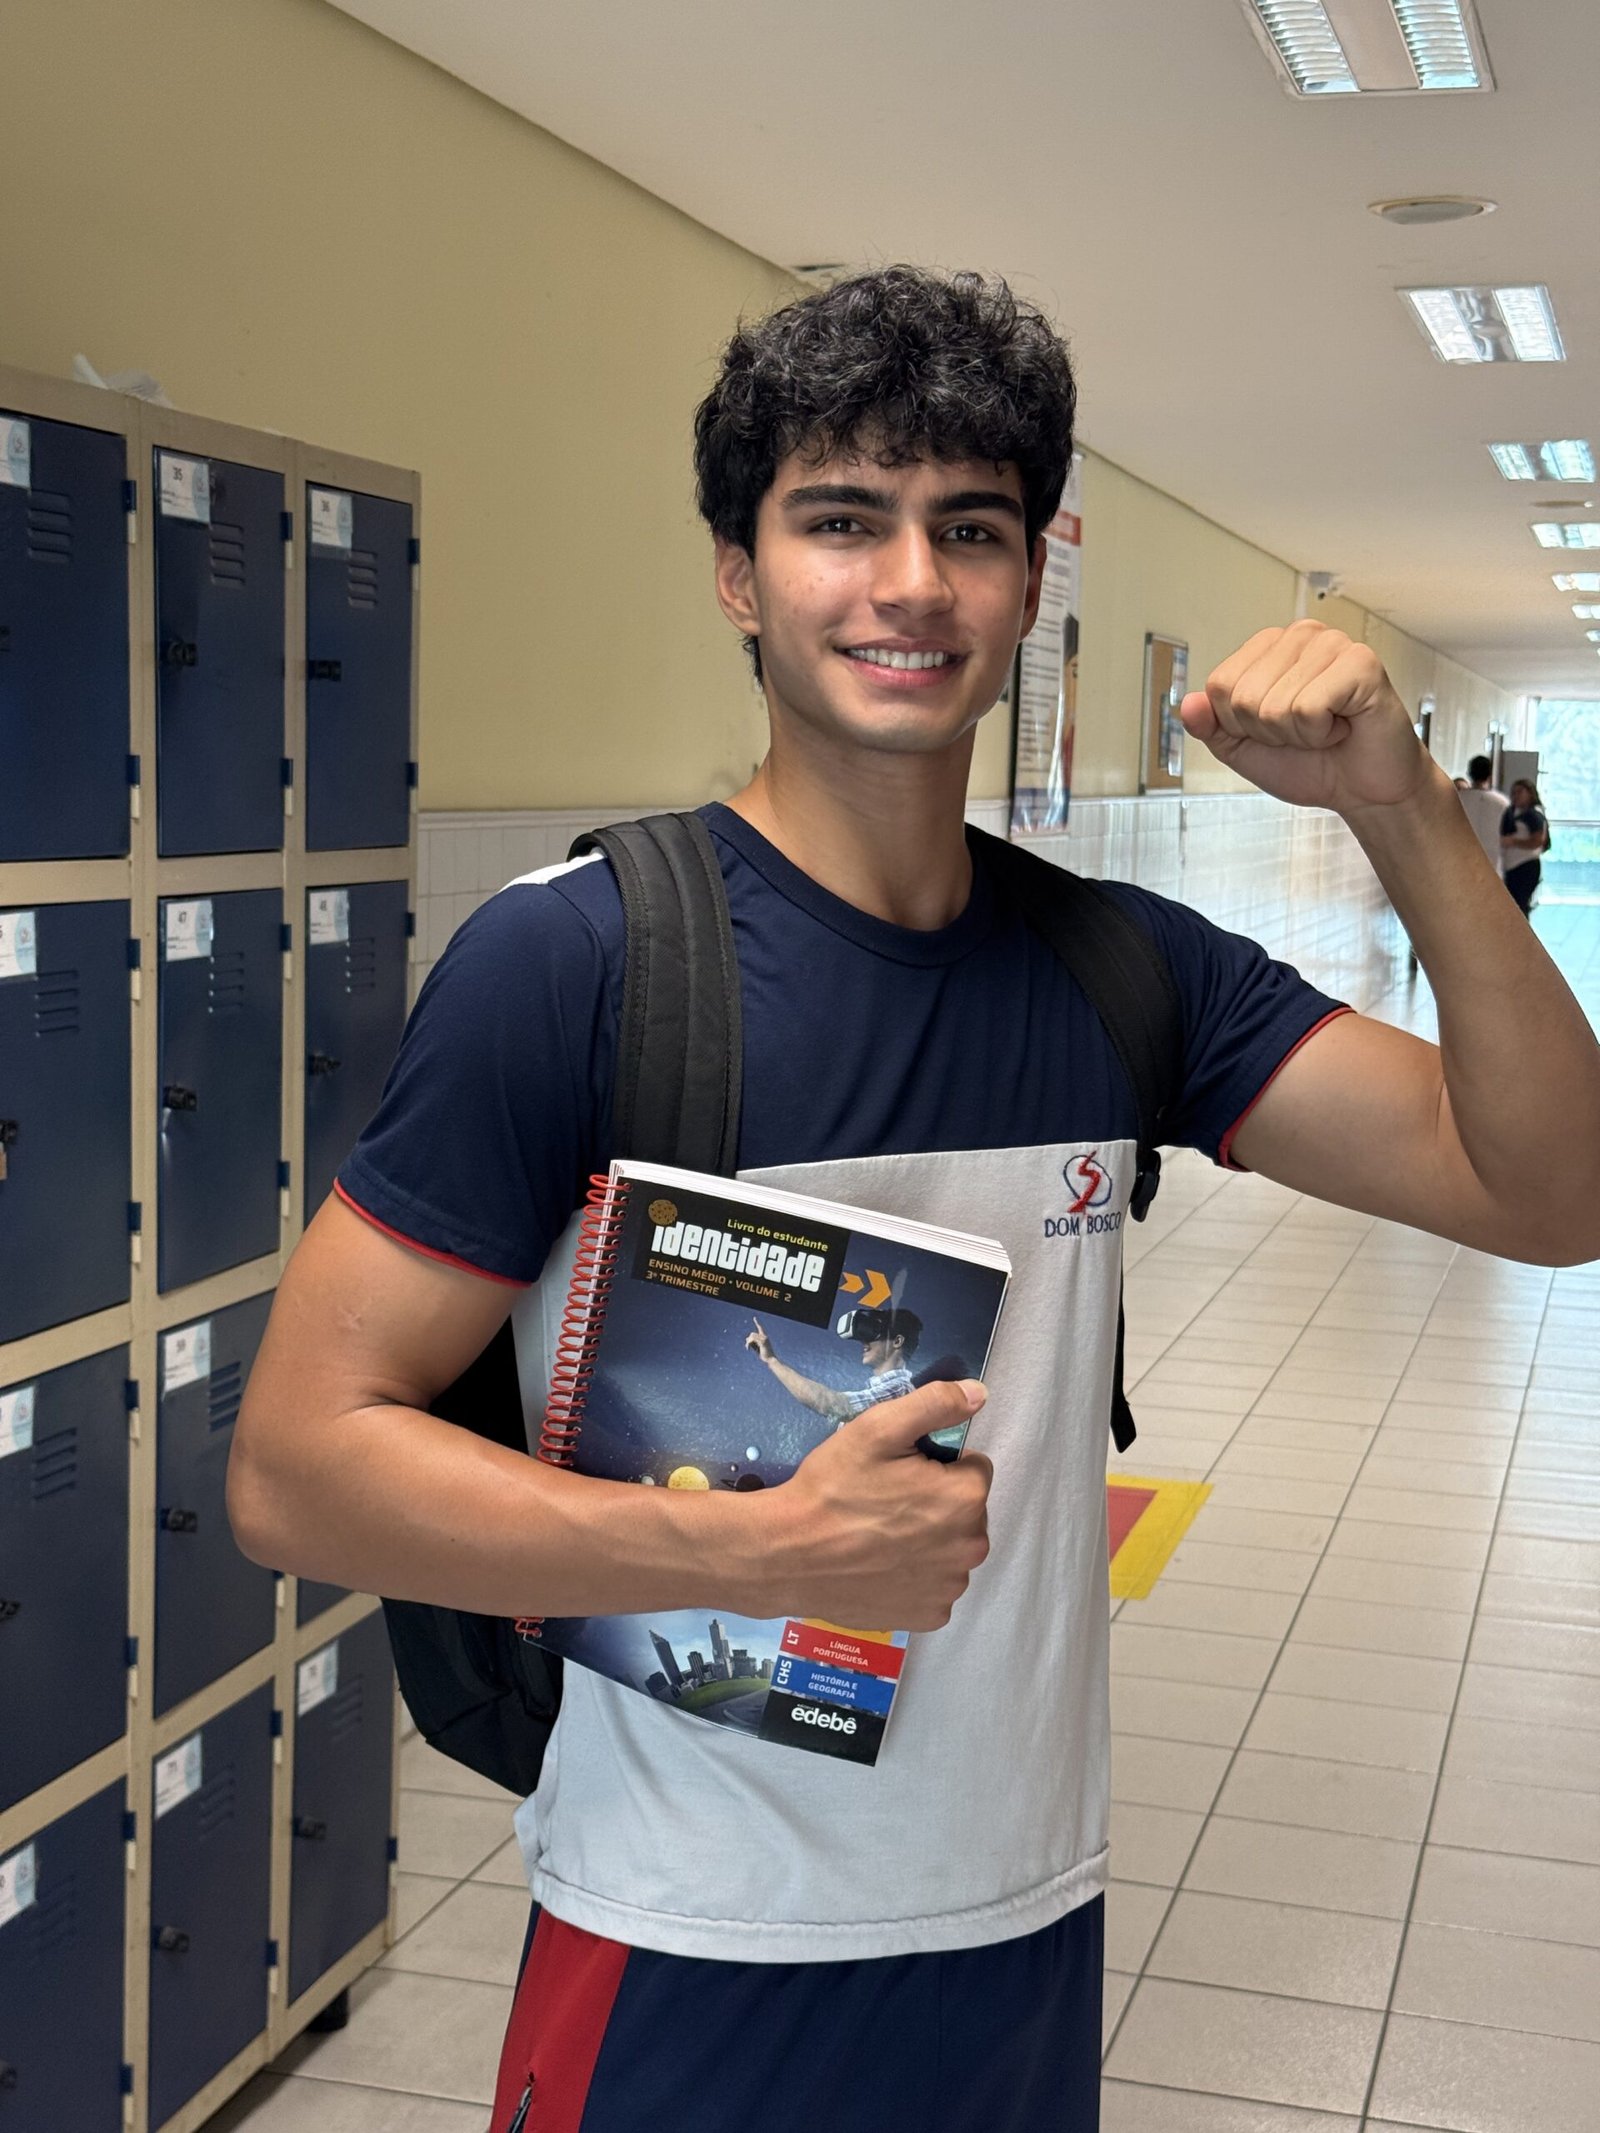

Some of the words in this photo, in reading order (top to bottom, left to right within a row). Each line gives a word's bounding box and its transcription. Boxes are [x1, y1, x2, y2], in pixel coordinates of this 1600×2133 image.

[172, 466, 183, 481] 35
[727, 1218, 755, 1234] Livro
[756, 1226, 771, 1237] do
[773, 1232, 828, 1251] estudante
[1045, 1217, 1079, 1237] DOM
[1087, 1212, 1121, 1234] BOSCO
[650, 1221, 826, 1293] identidade
[649, 1259, 689, 1275] ENSINO
[691, 1266, 727, 1286] MÉDIO
[735, 1279, 780, 1300] VOLUME
[783, 1293, 793, 1303] 2
[660, 1274, 720, 1296] TRIMESTRE
[787, 1630, 799, 1645] LT
[830, 1641, 860, 1654] LÍNGUA
[813, 1647, 868, 1666] PORTUGUESA
[777, 1660, 791, 1684] CHS
[811, 1672, 850, 1688] HISTÓRIA
[808, 1683, 855, 1699] GEOGRAFIA
[791, 1707, 856, 1734] edebê
